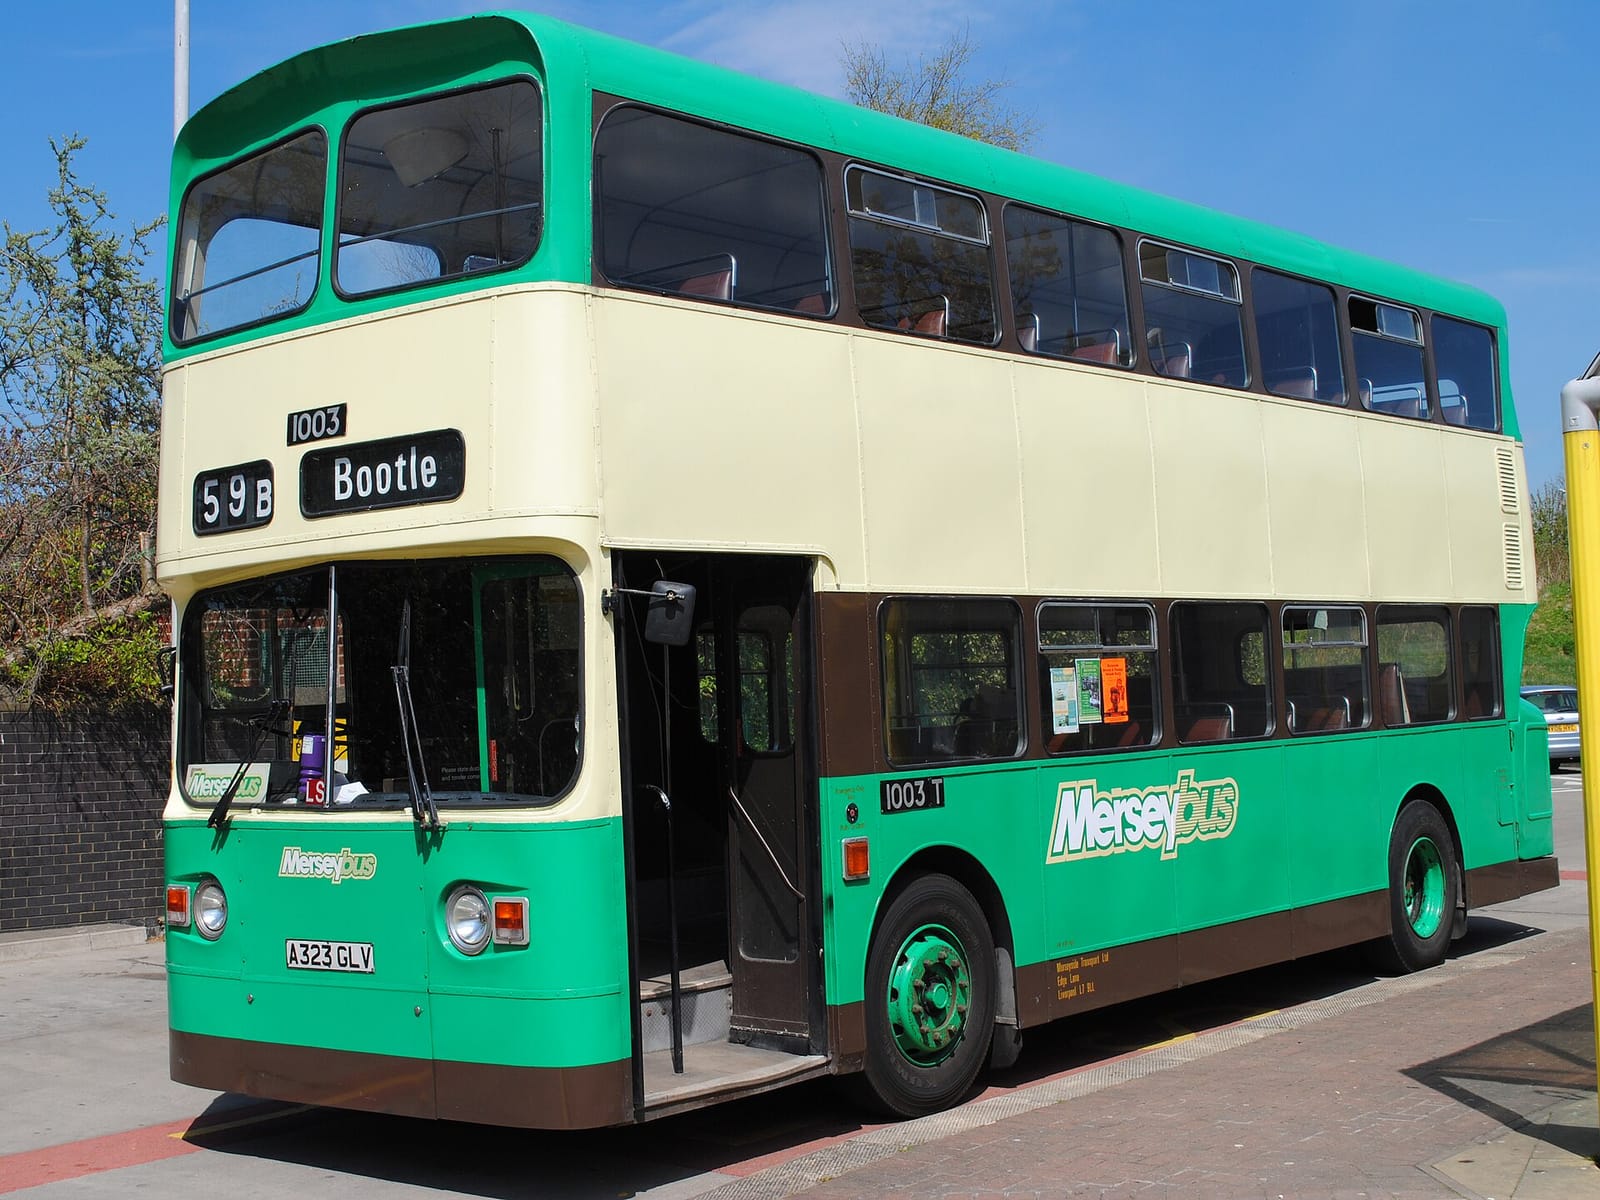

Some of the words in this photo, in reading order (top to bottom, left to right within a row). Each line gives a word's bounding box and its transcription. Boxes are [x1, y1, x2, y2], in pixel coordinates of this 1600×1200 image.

[291, 406, 341, 441] 1003
[334, 446, 437, 501] Bootle
[305, 780, 325, 803] LS
[885, 780, 926, 810] 1003
[931, 778, 943, 805] T
[1050, 773, 1237, 857] Merseybus
[280, 848, 376, 883] Merseybus
[289, 942, 332, 966] A323
[337, 945, 371, 969] GLV
[1081, 956, 1099, 967] Transport
[1057, 975, 1067, 987] Edge
[1069, 973, 1080, 983] Lane
[1058, 987, 1076, 999] Liverpool
[1079, 984, 1084, 994] L7
